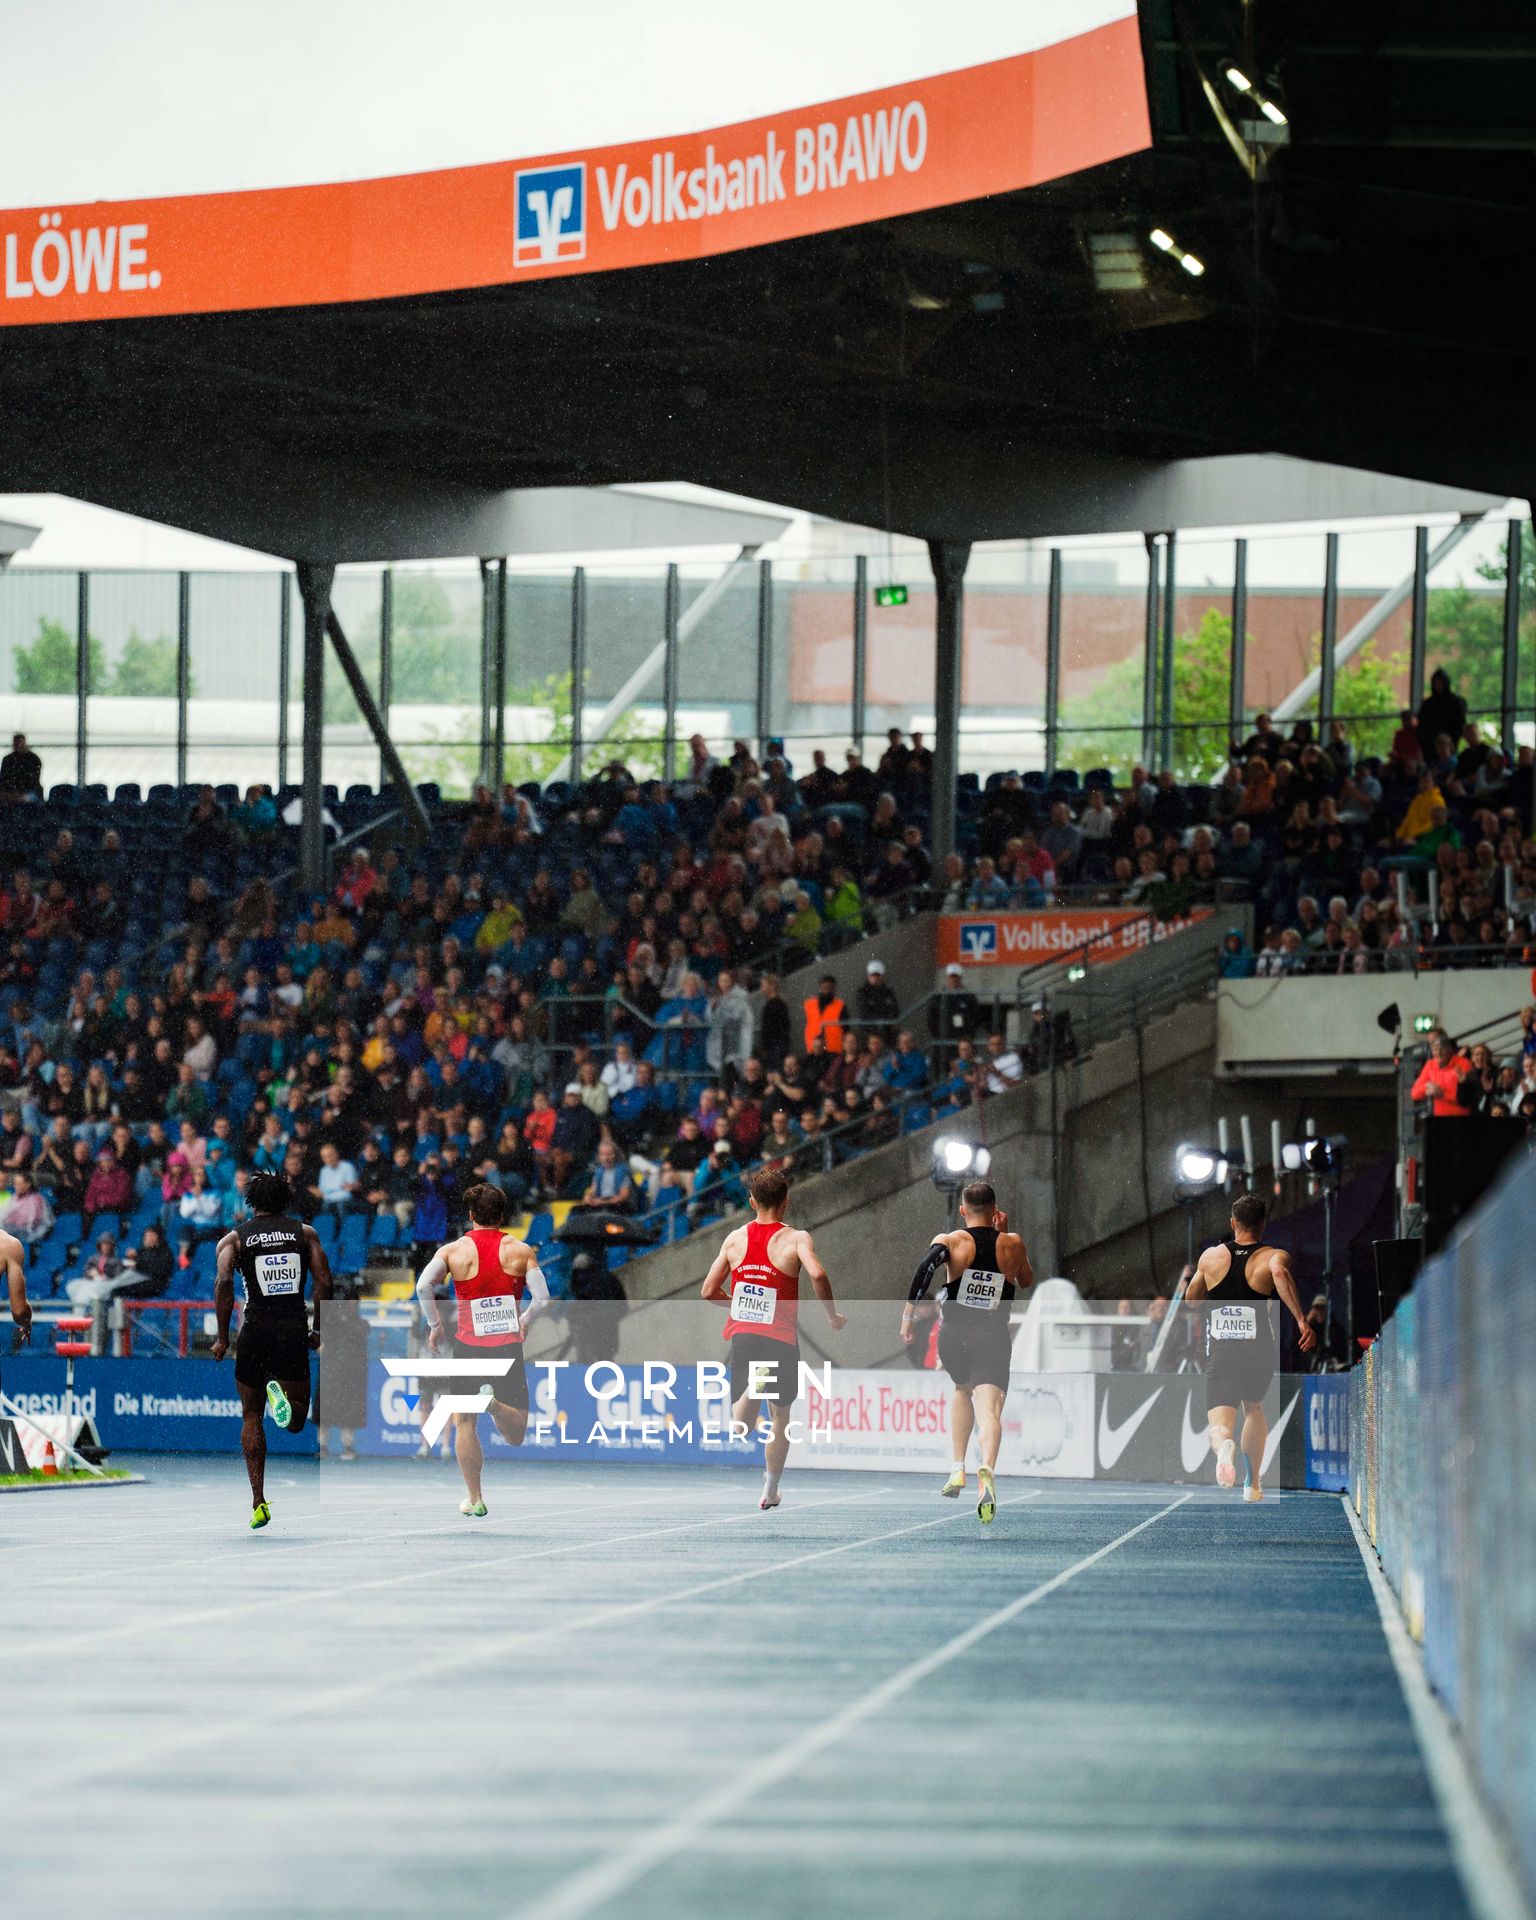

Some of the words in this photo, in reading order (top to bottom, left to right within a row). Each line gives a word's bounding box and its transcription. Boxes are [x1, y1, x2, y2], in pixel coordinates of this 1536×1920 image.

[595, 130, 787, 232] Volksbank
[795, 101, 928, 197] BRAWO
[5, 211, 162, 299] LÖWE.
[1003, 919, 1113, 950] Volksbank
[260, 1231, 296, 1242] Brillux
[262, 1268, 297, 1281] WUSU
[966, 1283, 996, 1297] GOER
[738, 1297, 769, 1312] FINKE
[475, 1309, 514, 1322] REDDEMANN
[1216, 1319, 1253, 1331] LANGE
[114, 1393, 139, 1416] Die
[877, 1386, 947, 1434] Forest
